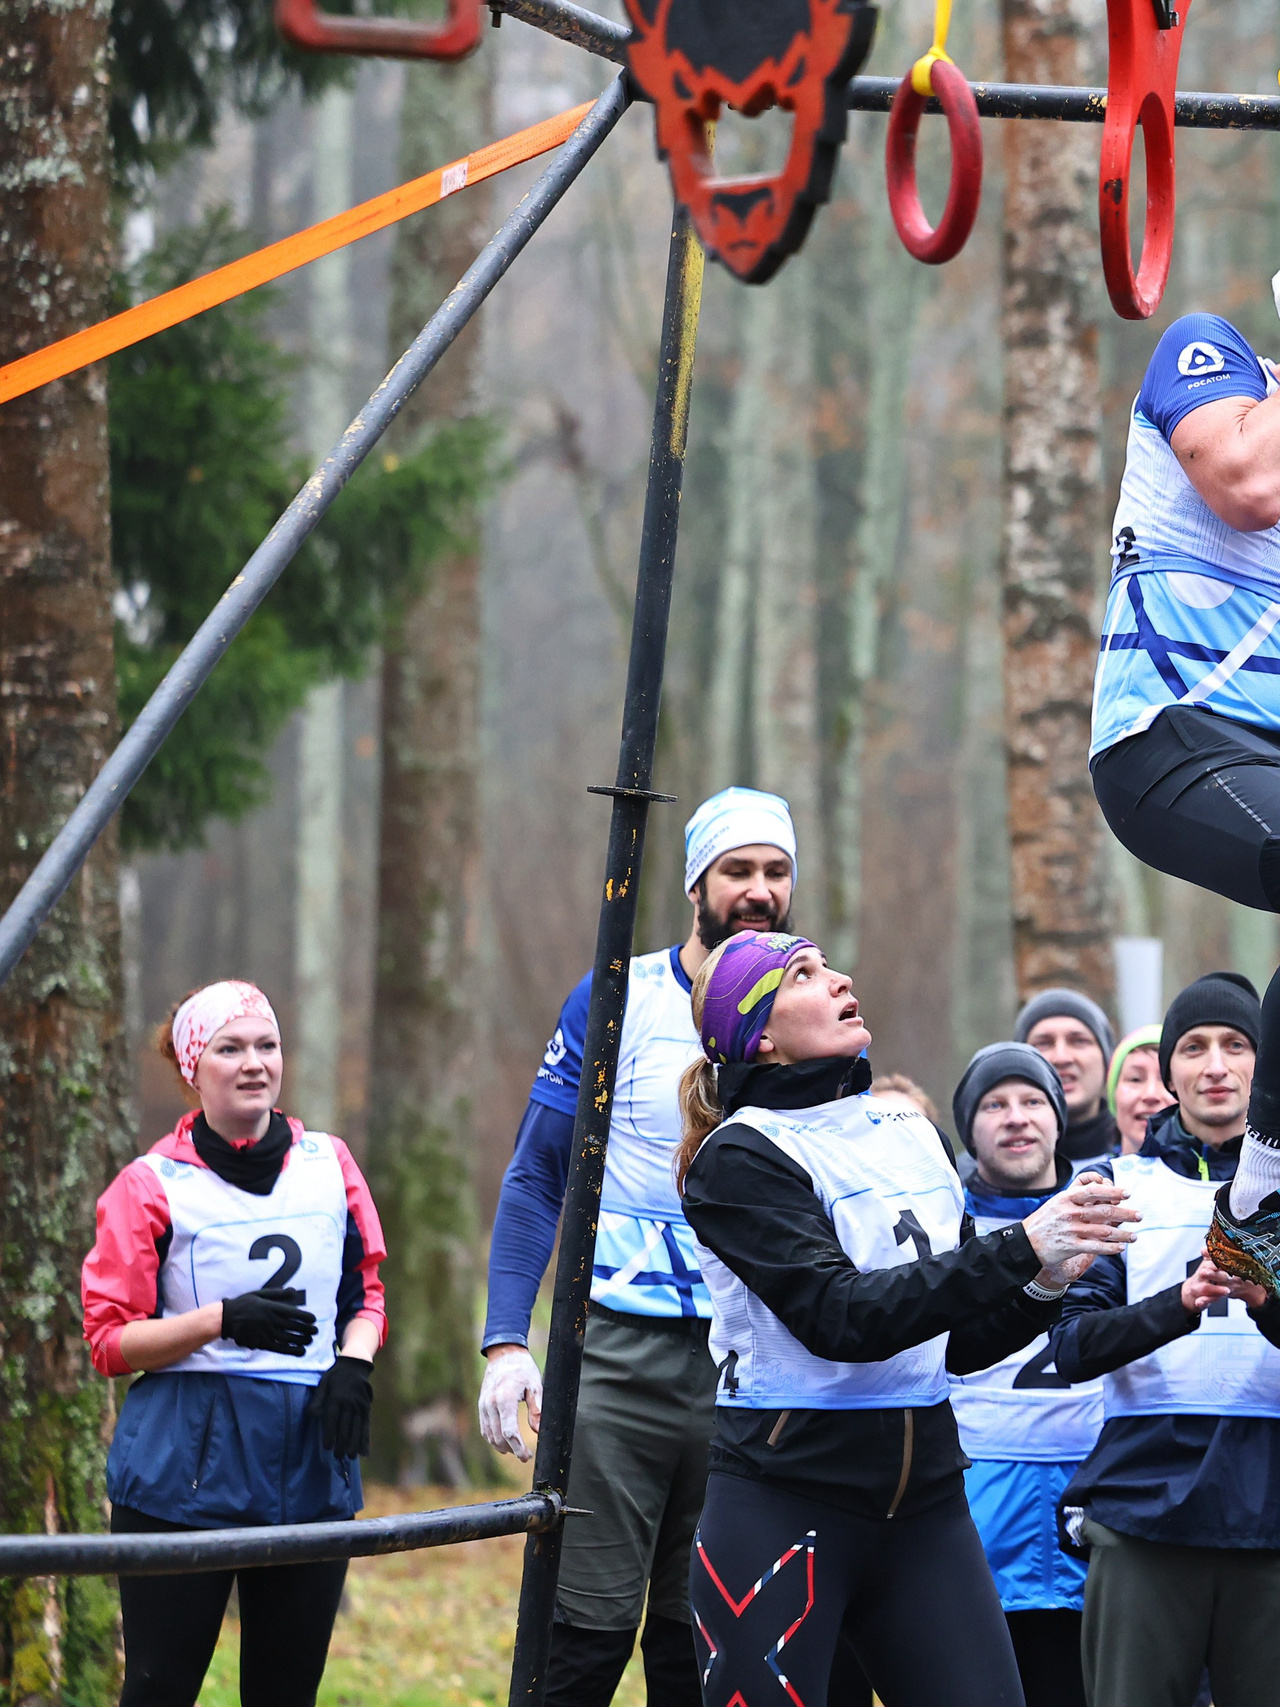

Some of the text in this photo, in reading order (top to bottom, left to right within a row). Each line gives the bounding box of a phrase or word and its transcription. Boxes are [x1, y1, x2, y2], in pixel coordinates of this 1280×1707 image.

[1187, 373, 1231, 390] РОСАТОМ
[892, 1208, 933, 1259] 1
[248, 1233, 307, 1306] 2
